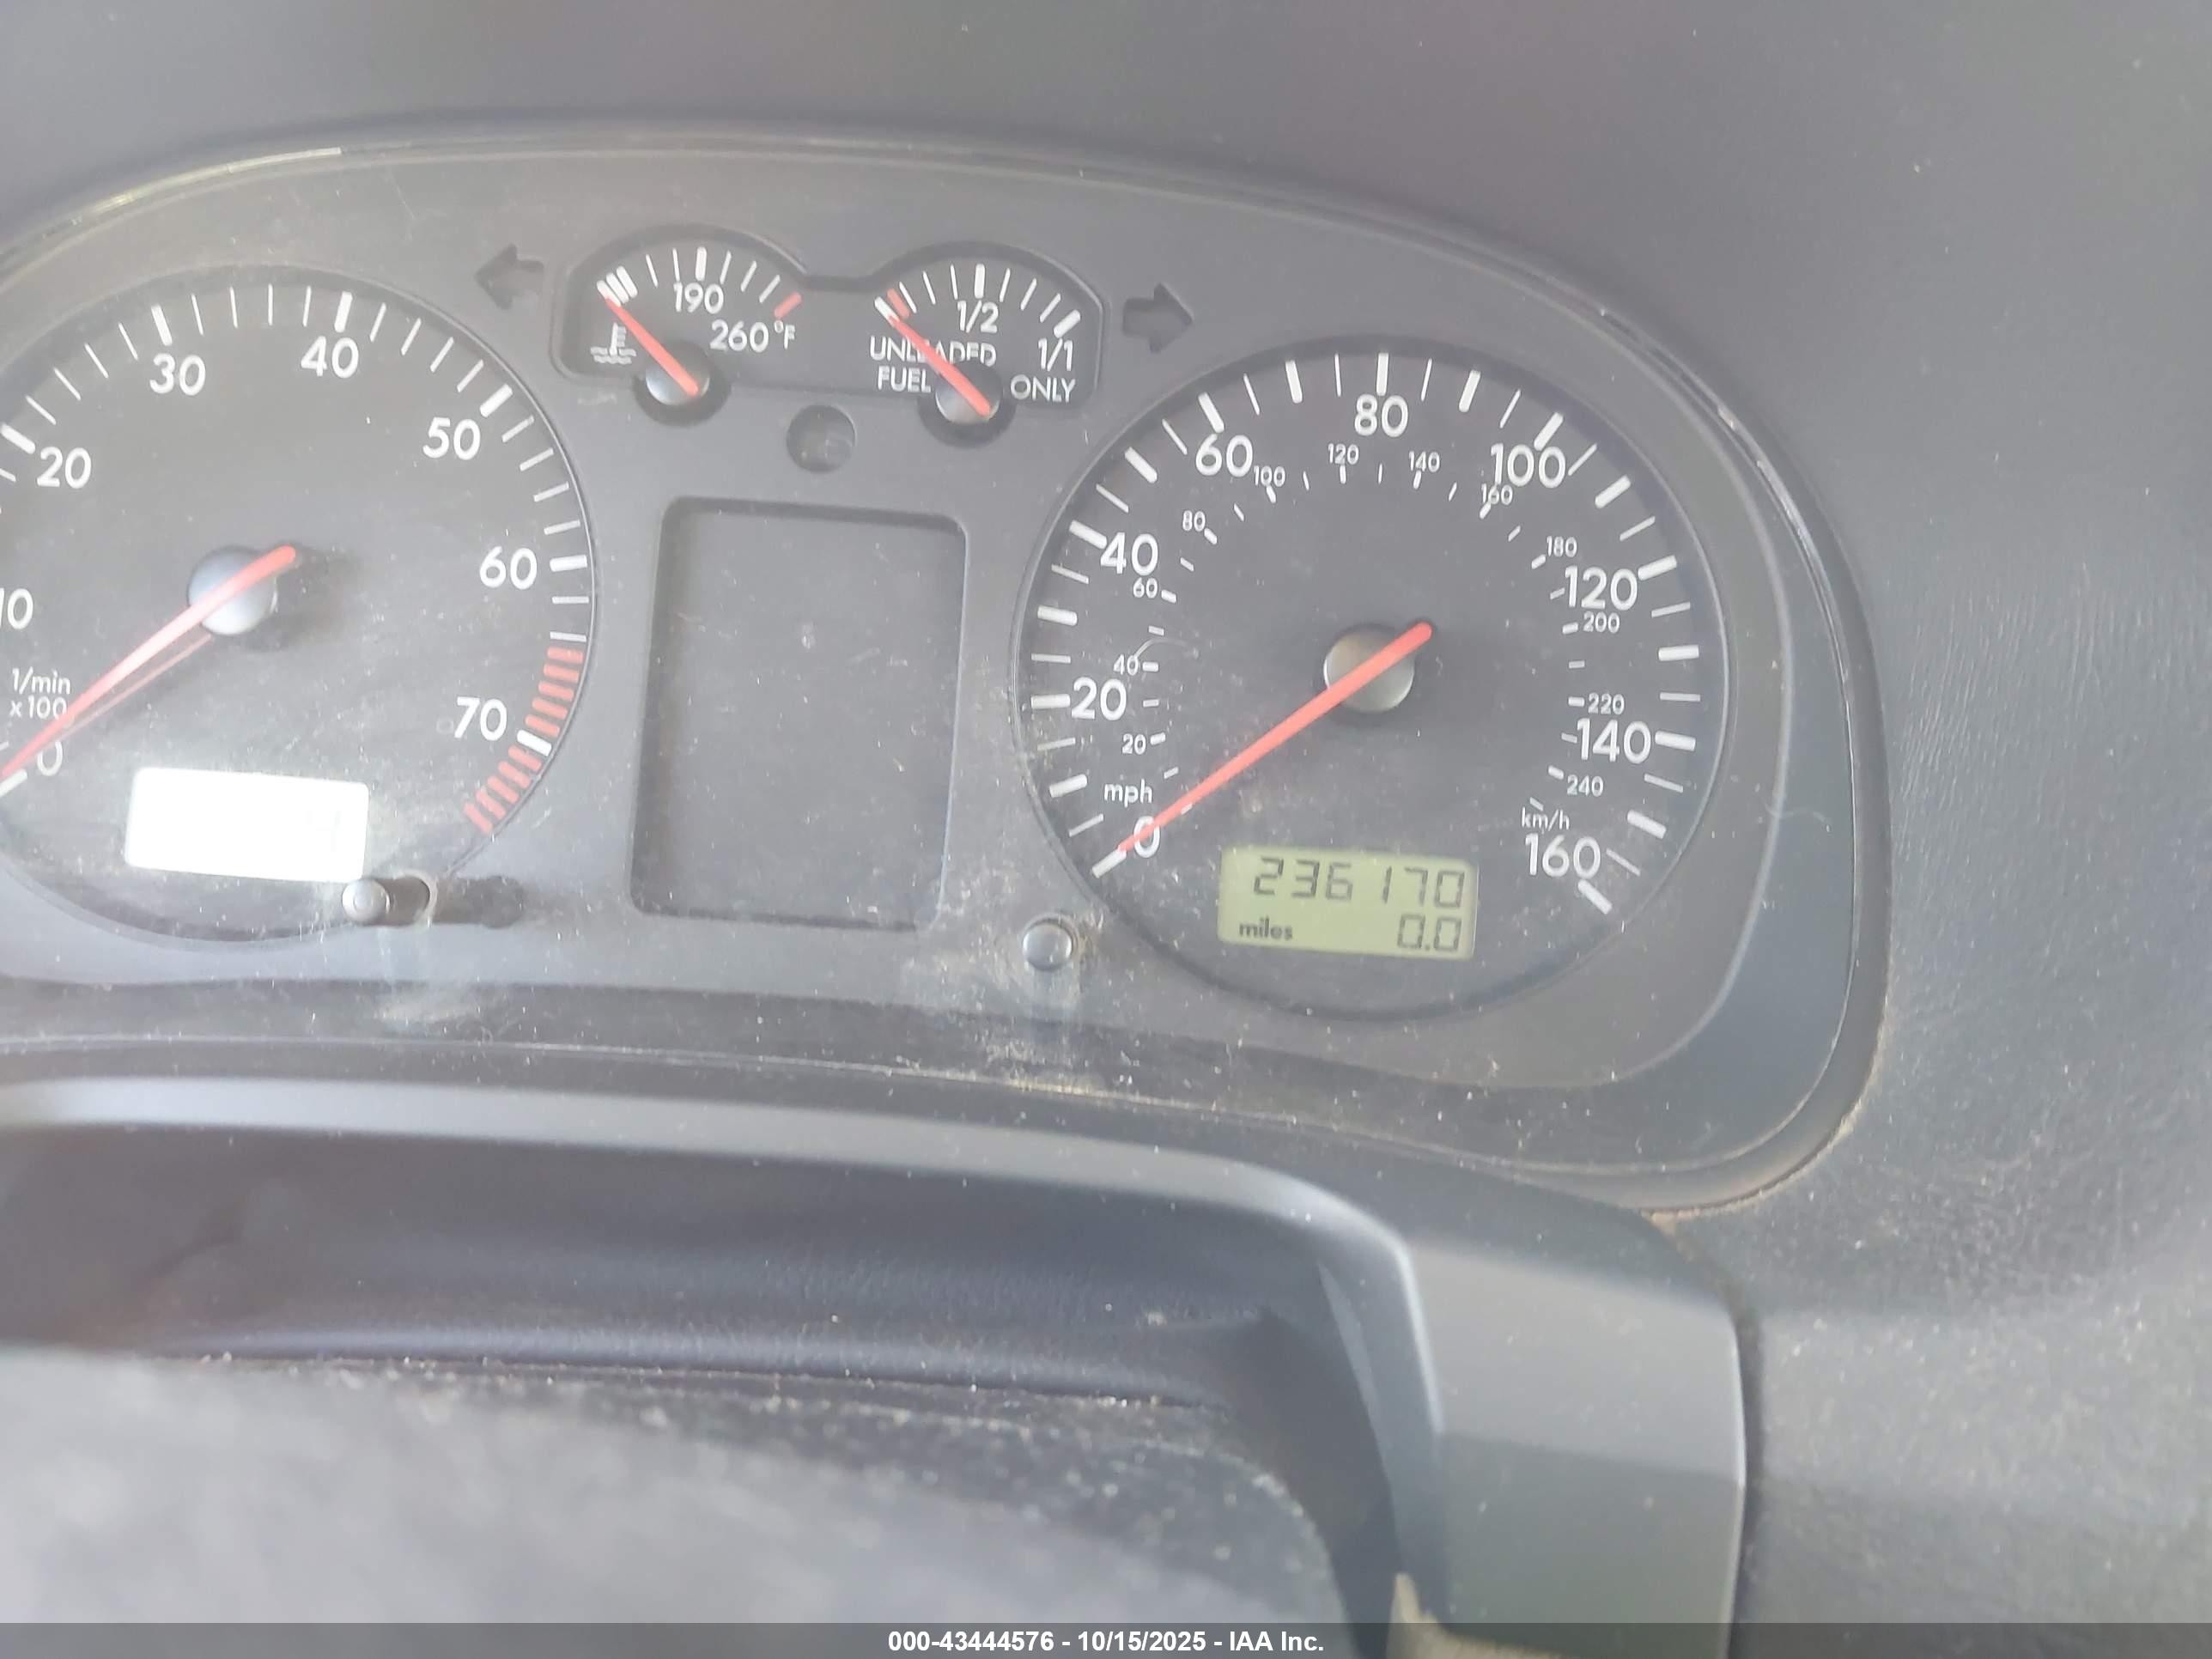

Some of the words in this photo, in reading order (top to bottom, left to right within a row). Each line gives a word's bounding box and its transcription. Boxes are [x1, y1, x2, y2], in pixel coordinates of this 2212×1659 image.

[673, 283, 724, 314] 190
[957, 300, 1000, 333] 1/2
[301, 337, 360, 379] 40
[1037, 338, 1073, 372] 1/1
[149, 353, 207, 396] 30
[878, 366, 932, 393] FUEL
[1009, 374, 1076, 403] ONLY
[1354, 394, 1408, 438] 80
[422, 416, 482, 459] 50
[1328, 443, 1359, 465] 120
[36, 447, 93, 489] 20
[1195, 434, 1254, 477] 60
[1408, 451, 1441, 473] 140
[1491, 442, 1567, 489] 100
[1254, 465, 1286, 487] 100
[1481, 483, 1514, 505] 160
[1182, 510, 1206, 532] 80
[1100, 532, 1159, 576] 40
[1546, 536, 1578, 557] 180
[478, 546, 538, 590] 60
[1133, 577, 1158, 599] 60
[1565, 565, 1638, 611] 120
[1583, 612, 1620, 634] 200
[12, 666, 71, 696] 1/min
[1113, 654, 1139, 676] 40
[1071, 677, 1127, 721] 20
[1587, 693, 1625, 715] 220
[454, 696, 508, 741] 70
[1121, 733, 1146, 755] 20
[1577, 718, 1651, 764] 140
[1103, 779, 1154, 807] mph
[1566, 775, 1604, 797] 240
[1521, 807, 1571, 831] km/h
[1133, 816, 1160, 859] 0
[1525, 833, 1601, 879] 160
[1254, 856, 1466, 909] 236170
[1238, 917, 1293, 941] miles
[1397, 913, 1462, 952] 0.0
